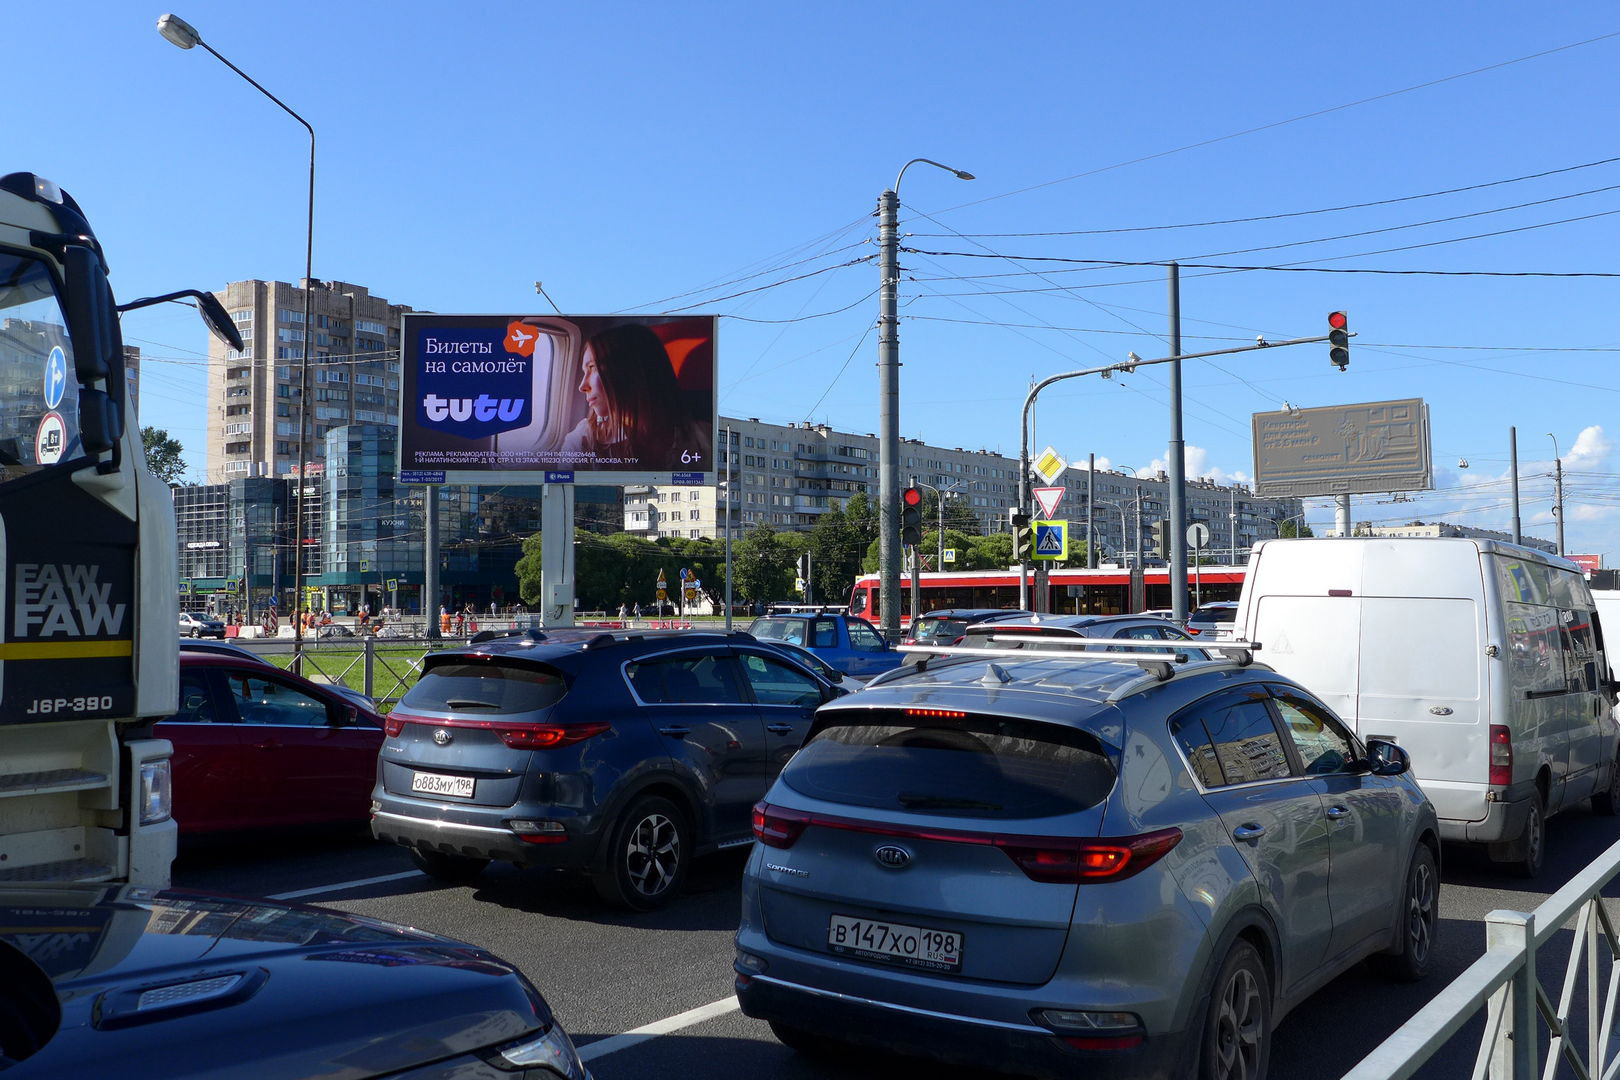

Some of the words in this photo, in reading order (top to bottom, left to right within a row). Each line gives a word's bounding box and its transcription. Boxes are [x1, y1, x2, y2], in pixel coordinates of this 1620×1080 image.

[425, 338, 493, 354] Билеты
[425, 361, 446, 373] на
[451, 358, 527, 373] самолёт
[423, 394, 525, 422] tutu
[680, 449, 702, 464] 6+
[14, 603, 127, 637] FAW
[26, 696, 113, 714] J6P-390
[880, 849, 902, 863] KIA
[766, 863, 809, 878] SPORTAGE
[835, 921, 917, 954] В147ХО
[922, 931, 955, 954] 198
[927, 951, 944, 960] RUS
